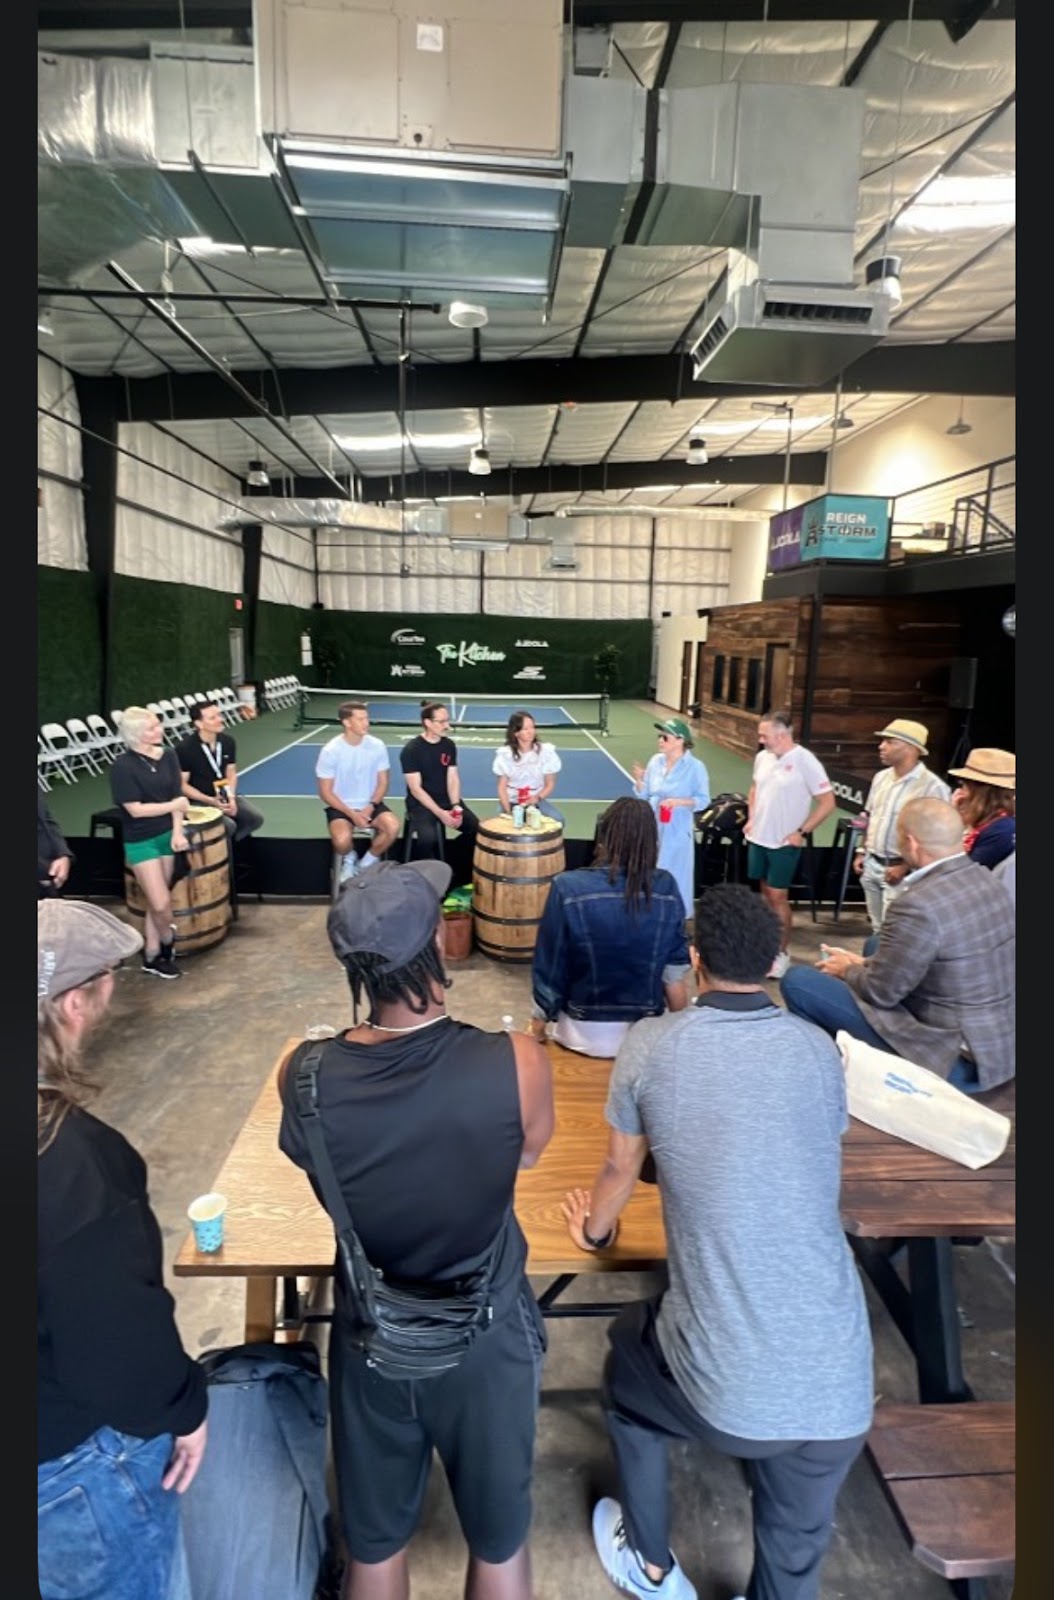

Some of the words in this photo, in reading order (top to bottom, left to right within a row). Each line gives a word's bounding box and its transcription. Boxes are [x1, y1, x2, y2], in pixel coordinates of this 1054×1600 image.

[826, 512, 867, 524] REIGN
[818, 524, 877, 537] STORM
[458, 640, 507, 667] Kitchen
[832, 781, 864, 805] OOLA
